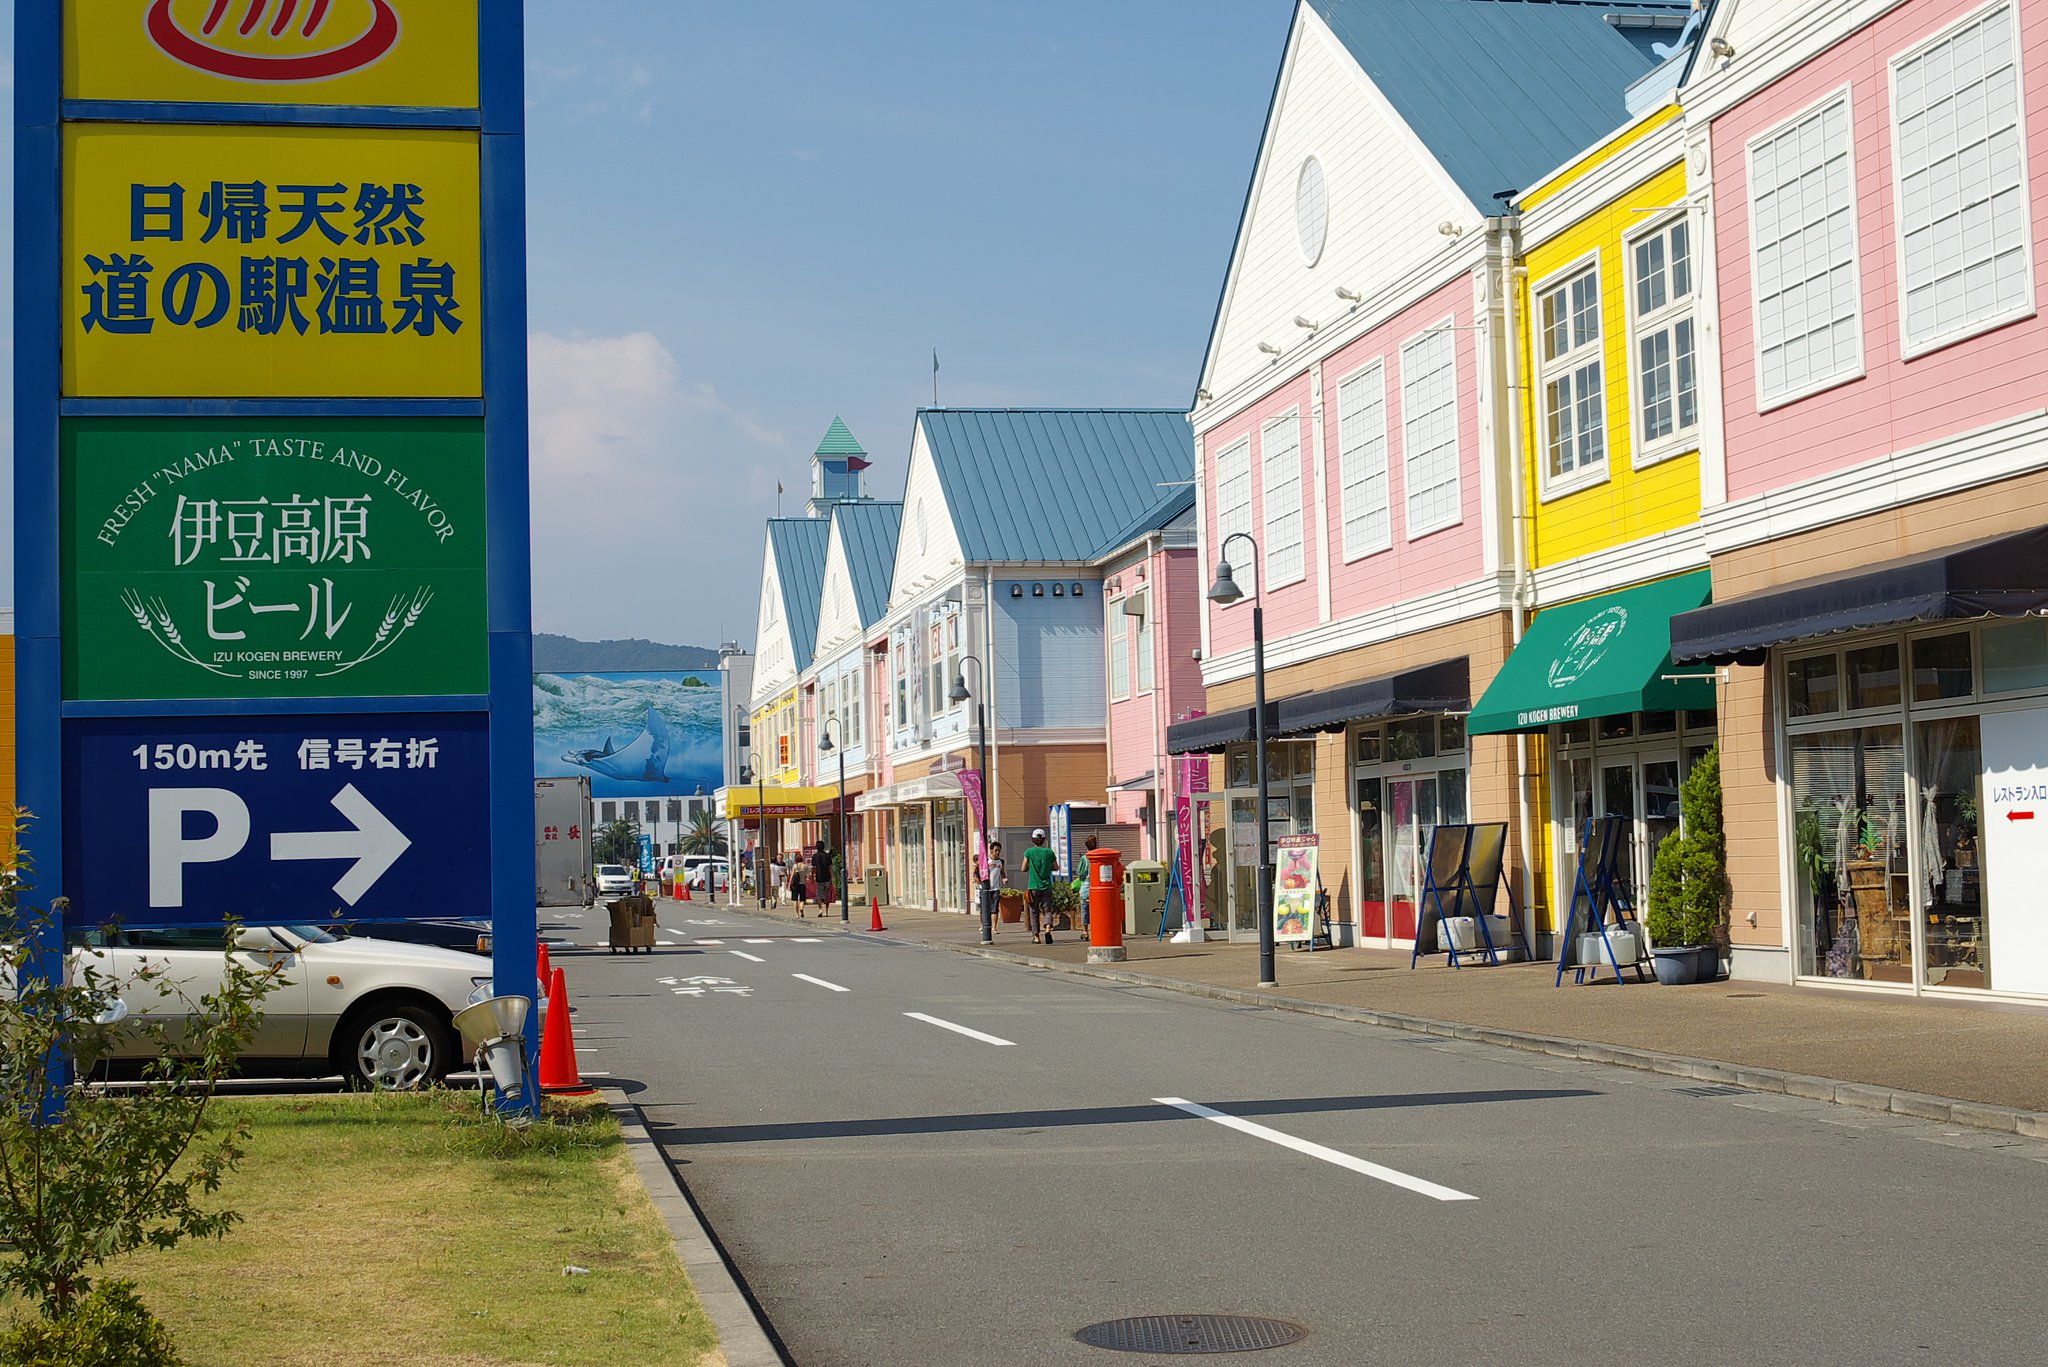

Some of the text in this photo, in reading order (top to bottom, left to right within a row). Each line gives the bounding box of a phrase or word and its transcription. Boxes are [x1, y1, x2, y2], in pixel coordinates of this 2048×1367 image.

[130, 182, 425, 249] 日帰天然
[81, 254, 462, 337] 道の駅温泉
[97, 482, 156, 547] FRESH
[249, 438, 325, 462] TASTE
[330, 447, 382, 477] AND
[385, 468, 455, 544] FLAVOR
[168, 493, 373, 567] 伊豆高原
[203, 575, 352, 641] ビール
[213, 651, 343, 662] IZU KOGEN BREWERY
[248, 669, 309, 680] SINCE 1997
[1518, 704, 1579, 726] IZU KOGEN BREWERY
[133, 740, 267, 771] 150m先
[297, 738, 439, 770] 信号右折
[1994, 786, 2047, 803] レストラン入口
[148, 788, 251, 908] P
